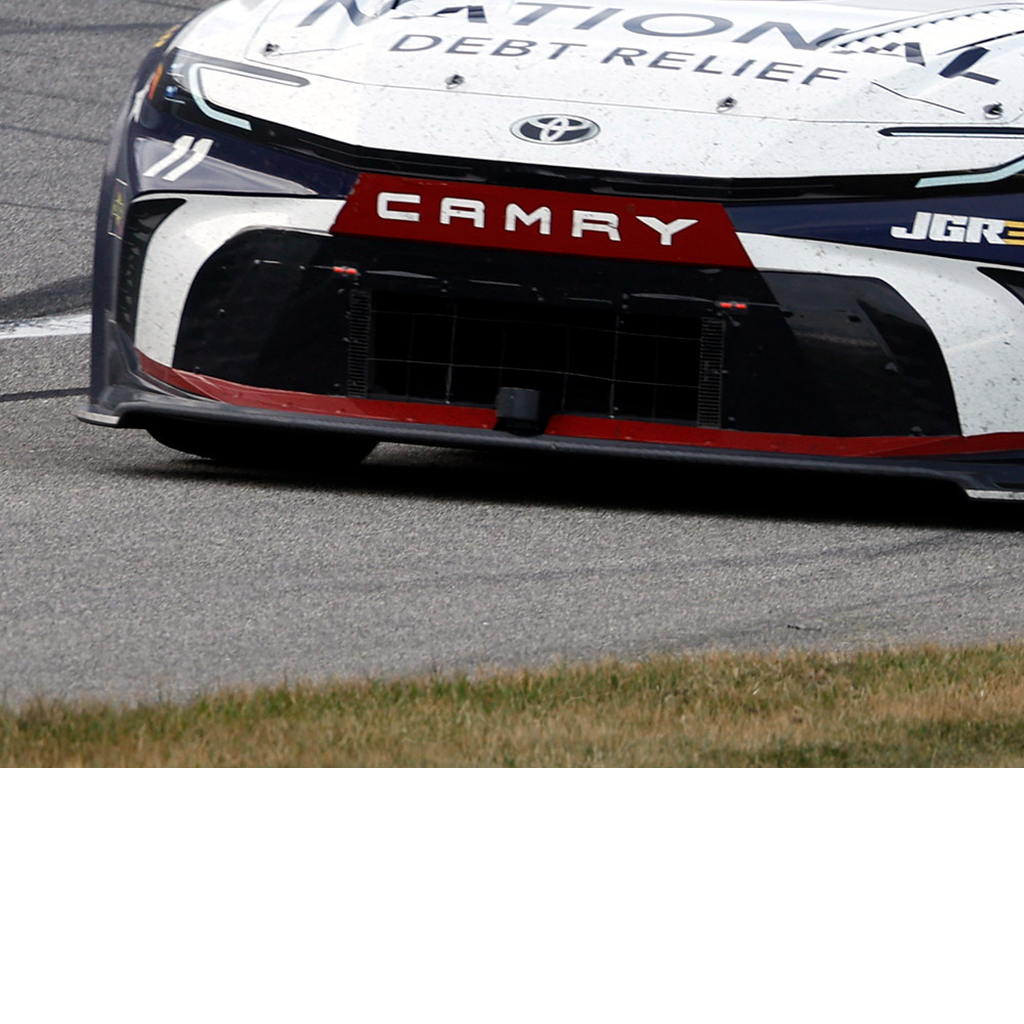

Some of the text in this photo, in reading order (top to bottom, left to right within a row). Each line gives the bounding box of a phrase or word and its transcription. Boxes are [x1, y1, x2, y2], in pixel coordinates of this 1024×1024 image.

[389, 34, 848, 86] DEBT RELIEF
[142, 135, 214, 182] 11
[376, 192, 699, 246] CAMRY
